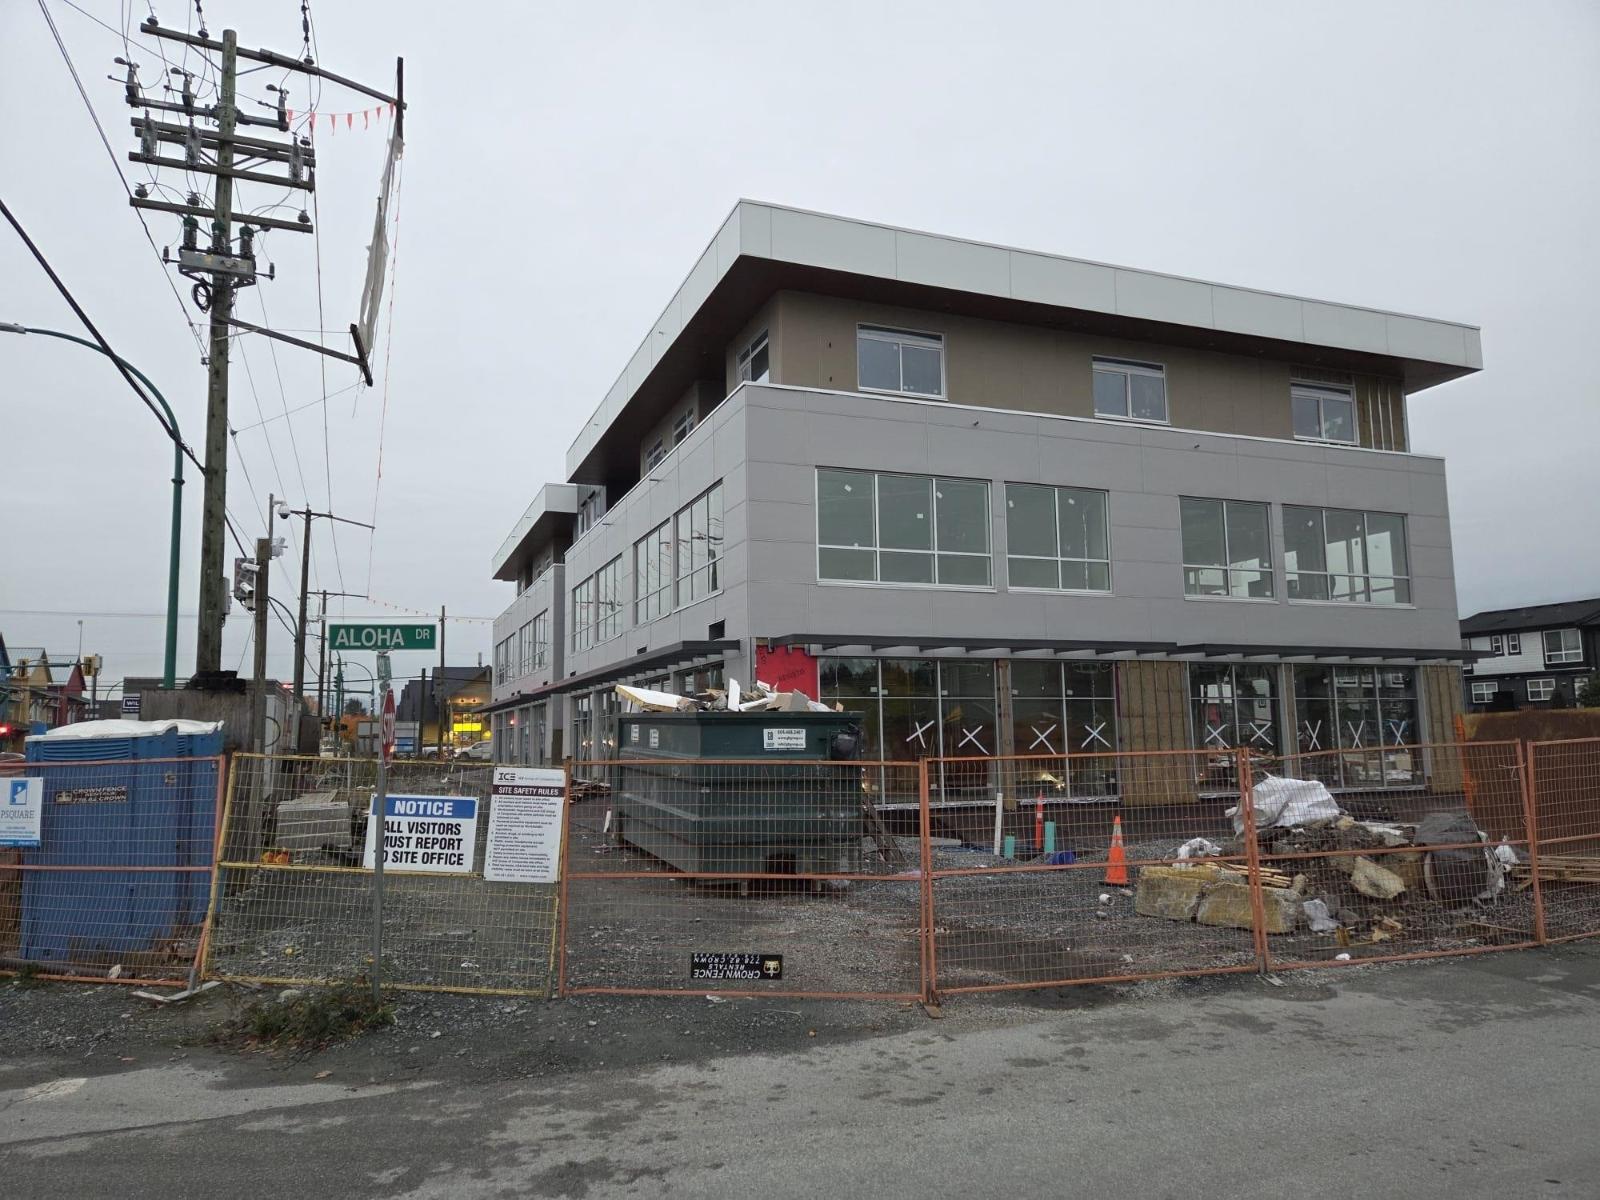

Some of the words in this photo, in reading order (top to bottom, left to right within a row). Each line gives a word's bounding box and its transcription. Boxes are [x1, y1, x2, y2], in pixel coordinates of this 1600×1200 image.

[335, 628, 405, 647] ALOHA
[415, 628, 430, 640] DR
[498, 772, 516, 781] ICE
[498, 786, 513, 794] SITE
[513, 786, 537, 796] SAFETY
[537, 788, 559, 796] RULES
[394, 800, 454, 816] NOTICE
[384, 820, 403, 834] ALL
[407, 821, 462, 836] VISITORS
[415, 836, 463, 851] REPORT
[391, 850, 418, 864] SITE
[421, 851, 464, 866] OFFICE
[693, 969, 724, 978] FENCE
[725, 969, 760, 979] CROWN
